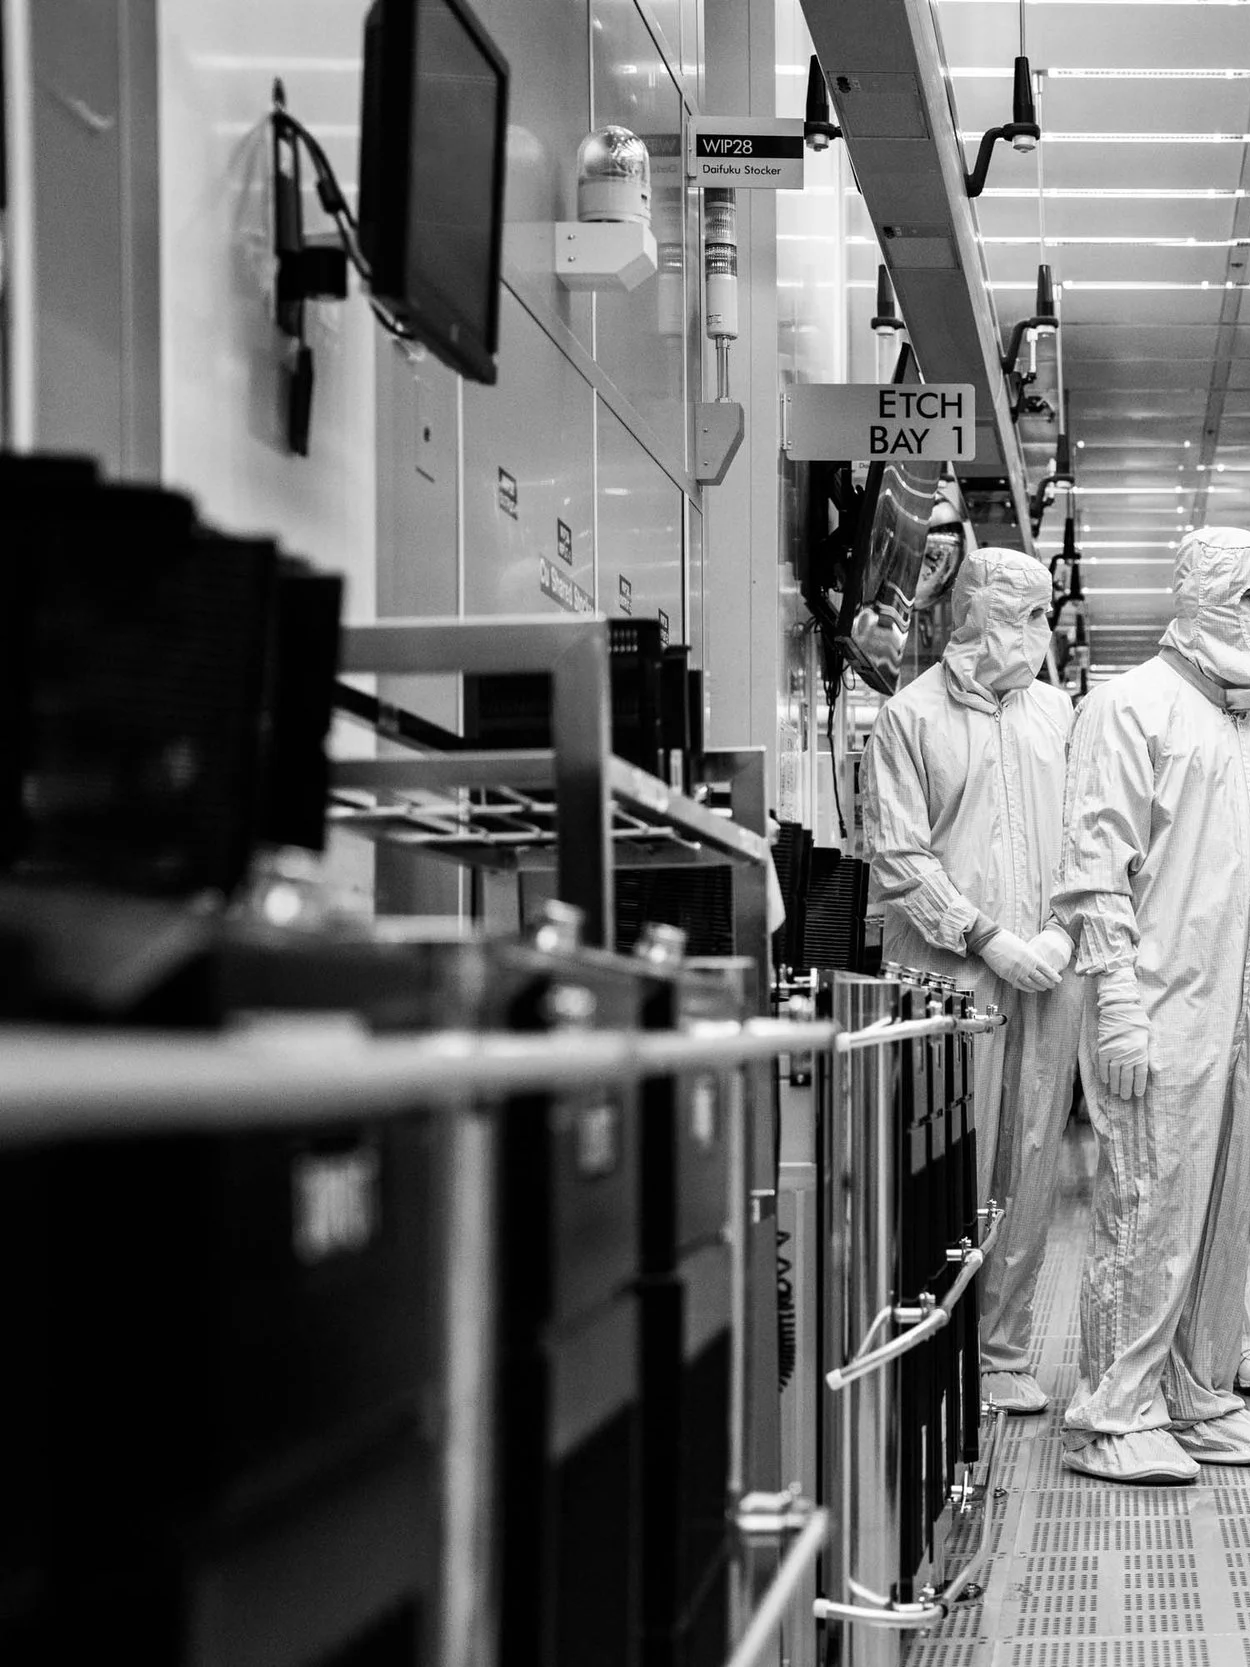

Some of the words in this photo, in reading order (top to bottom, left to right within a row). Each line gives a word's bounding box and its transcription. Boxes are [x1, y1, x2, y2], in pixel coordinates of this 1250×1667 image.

[703, 138, 753, 155] WIP28
[702, 164, 741, 176] Daifuku
[744, 165, 782, 176] Stocker
[879, 390, 962, 419] ETCH
[870, 426, 930, 454] BAY
[952, 426, 963, 454] 1
